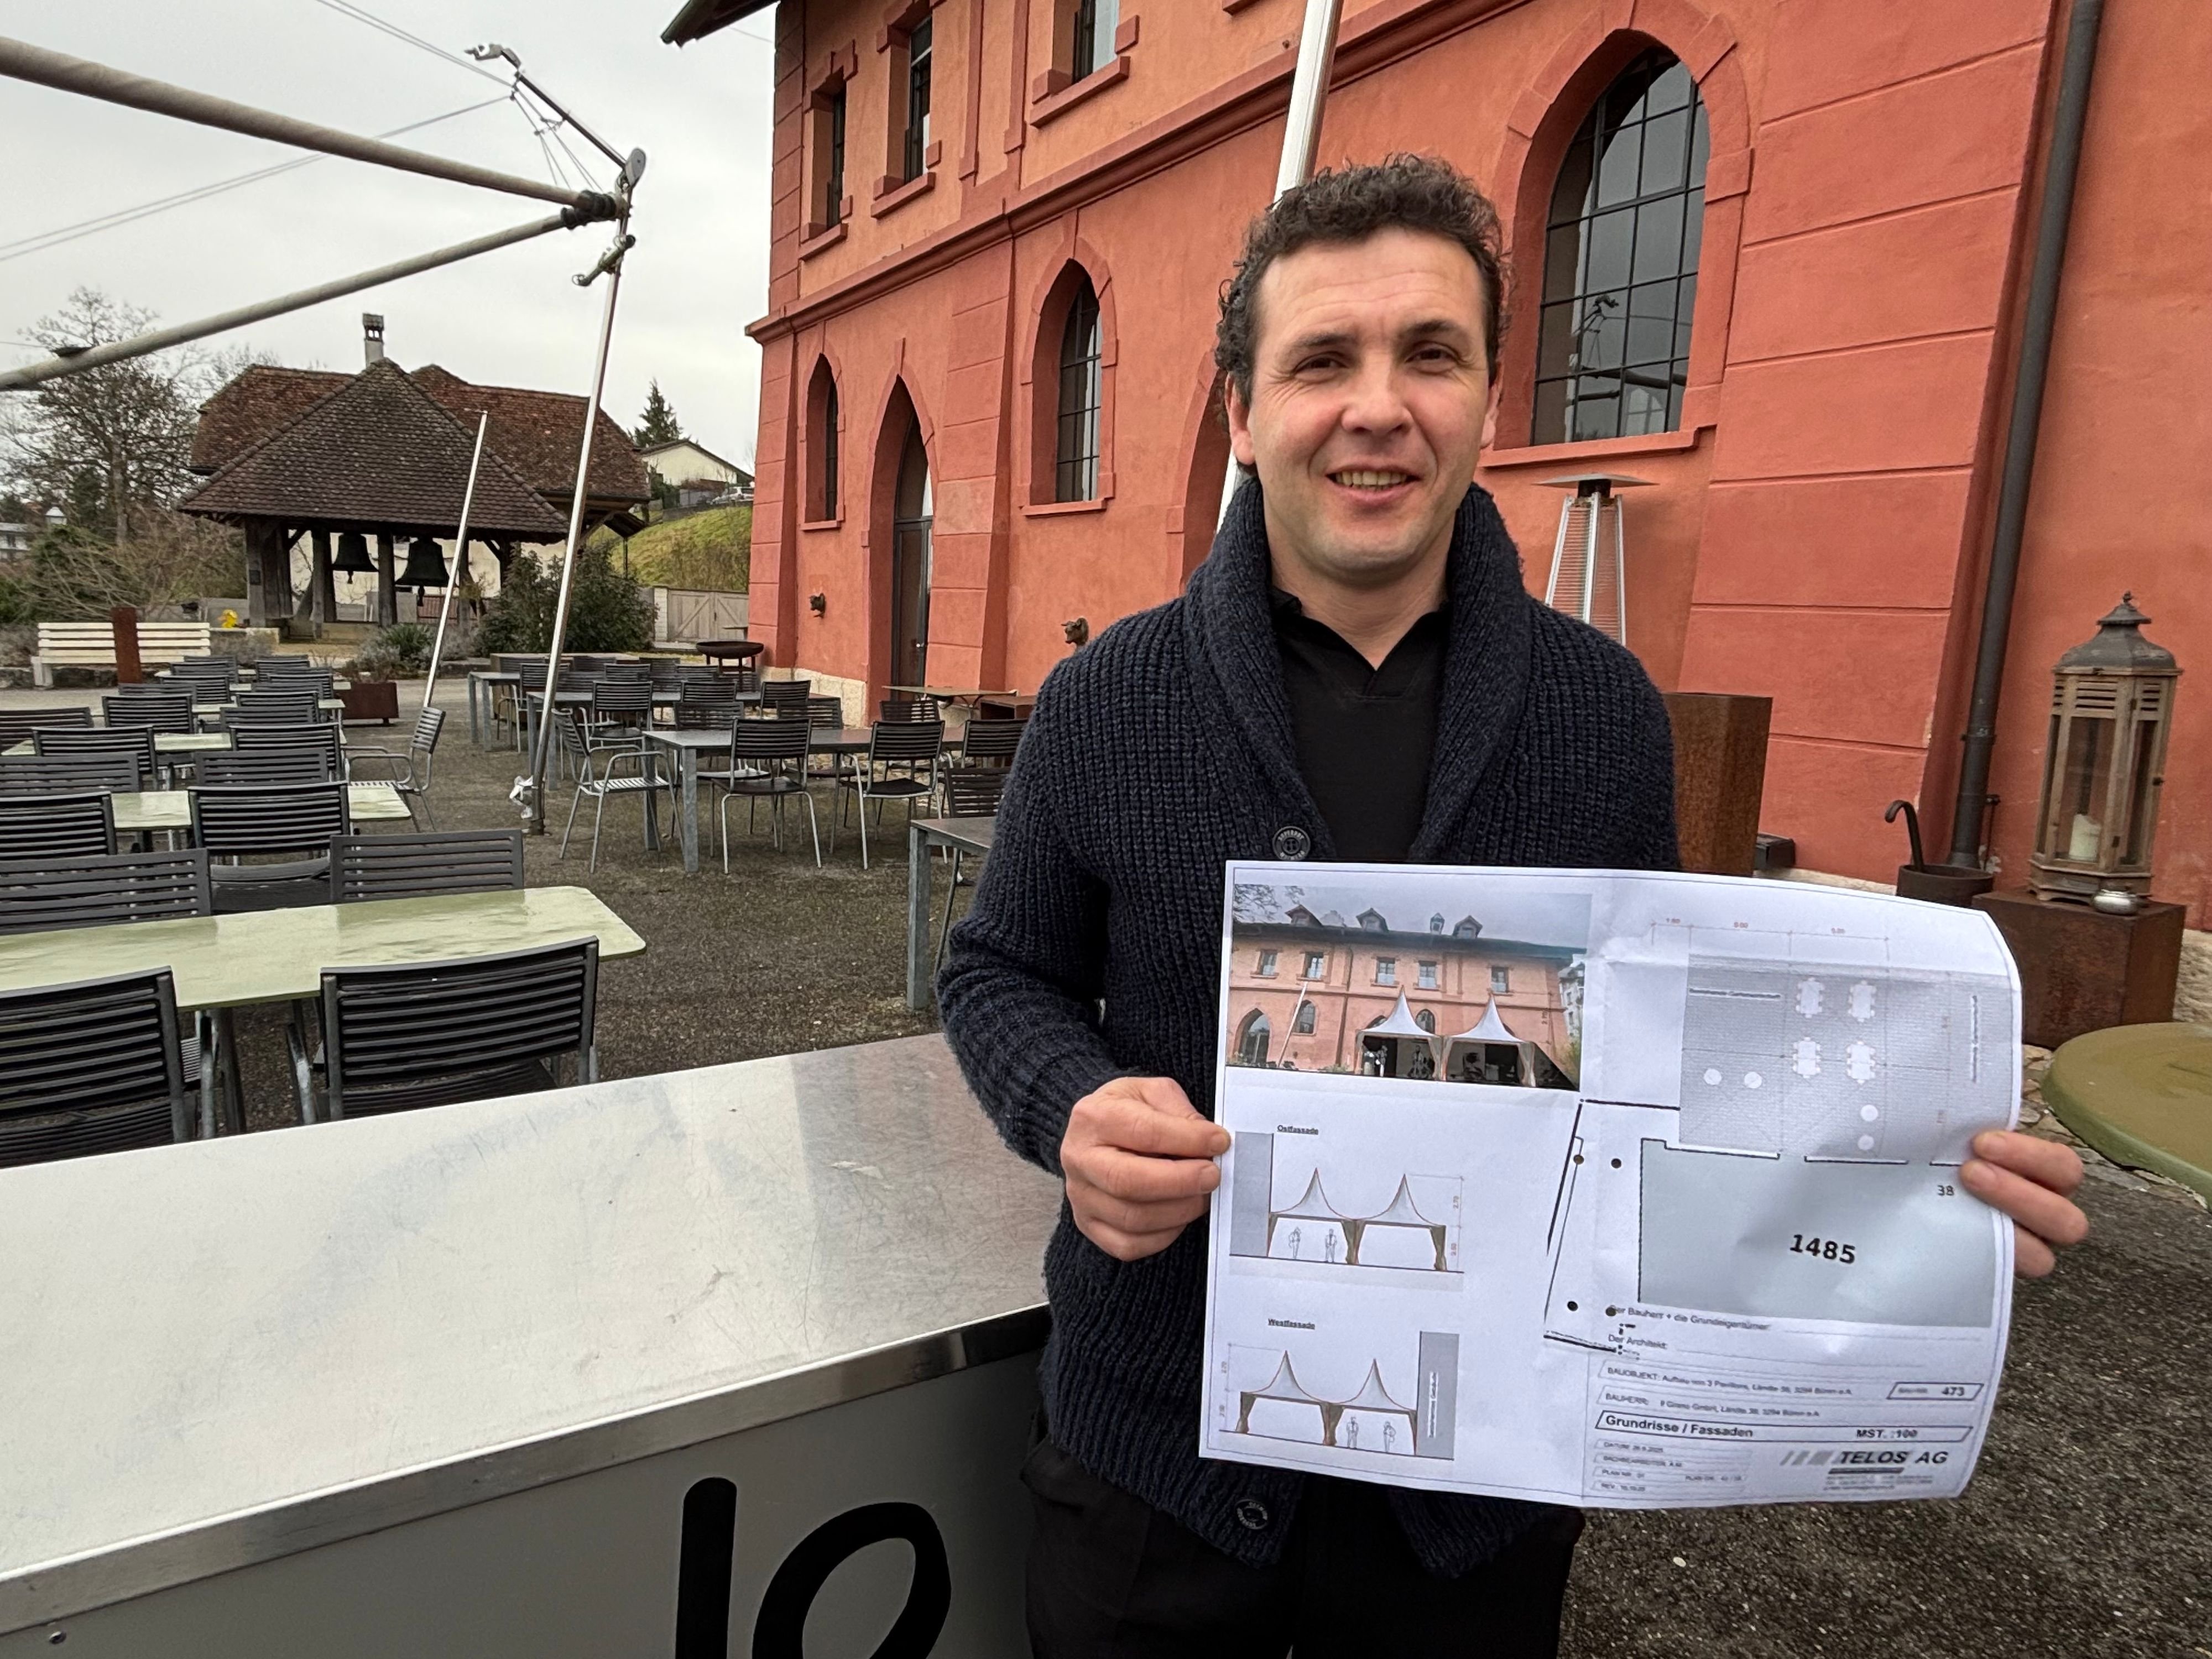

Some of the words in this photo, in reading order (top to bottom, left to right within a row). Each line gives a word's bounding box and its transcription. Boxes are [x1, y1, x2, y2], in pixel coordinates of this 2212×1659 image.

[1277, 1124, 1319, 1136] Ostfassade
[1937, 1185, 1955, 1196] 38
[1790, 1234, 1856, 1265] 1485
[1628, 1307, 1665, 1319] Bauherr
[1268, 1318, 1316, 1330] Westfassade
[1608, 1334, 1625, 1344] Der
[1941, 1386, 1965, 1396] 473
[1606, 1415, 1679, 1433] Grundrisse
[1682, 1423, 1688, 1433] /
[1690, 1423, 1754, 1438] Fassaden
[1856, 1429, 1887, 1439] MST.
[1840, 1450, 1910, 1464] TELOS
[1914, 1451, 1949, 1464] AG
